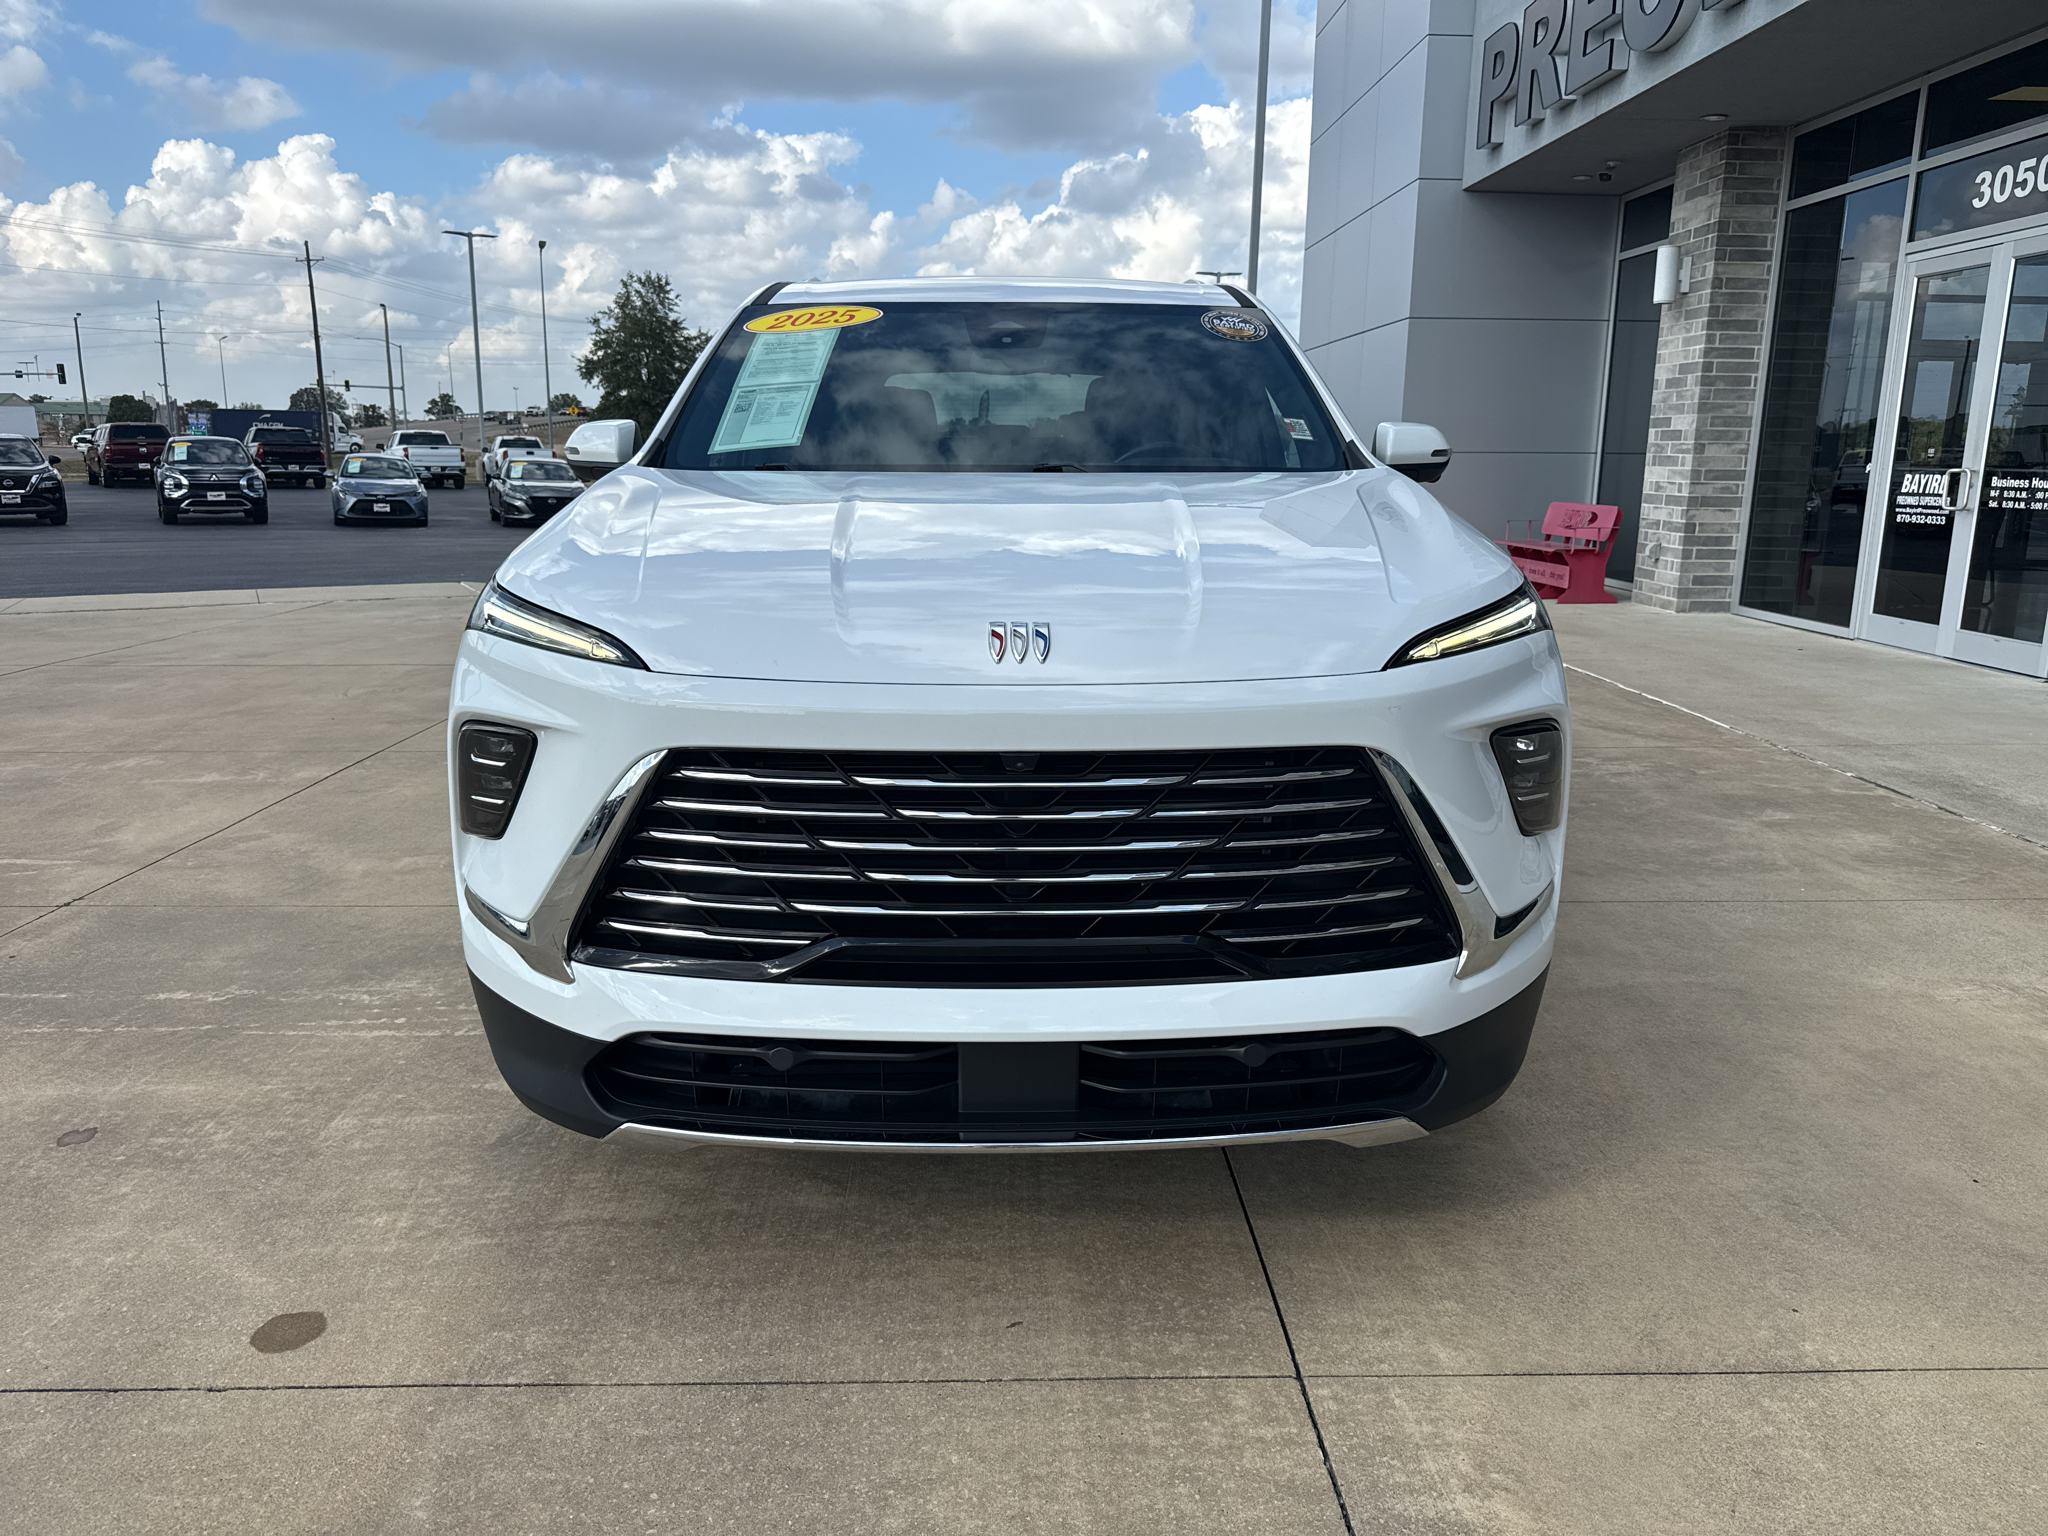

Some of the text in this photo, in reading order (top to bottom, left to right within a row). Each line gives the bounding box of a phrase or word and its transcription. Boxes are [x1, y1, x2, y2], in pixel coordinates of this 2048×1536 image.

[765, 309, 861, 330] 2025
[1213, 318, 1255, 330] BAYIRD
[1991, 476, 2030, 488] Business
[2003, 490, 2015, 498] 8:30
[1919, 496, 1951, 507] SUPERCENR
[2030, 502, 2043, 510] 5:00
[1895, 514, 1946, 525] 870-932-0333
